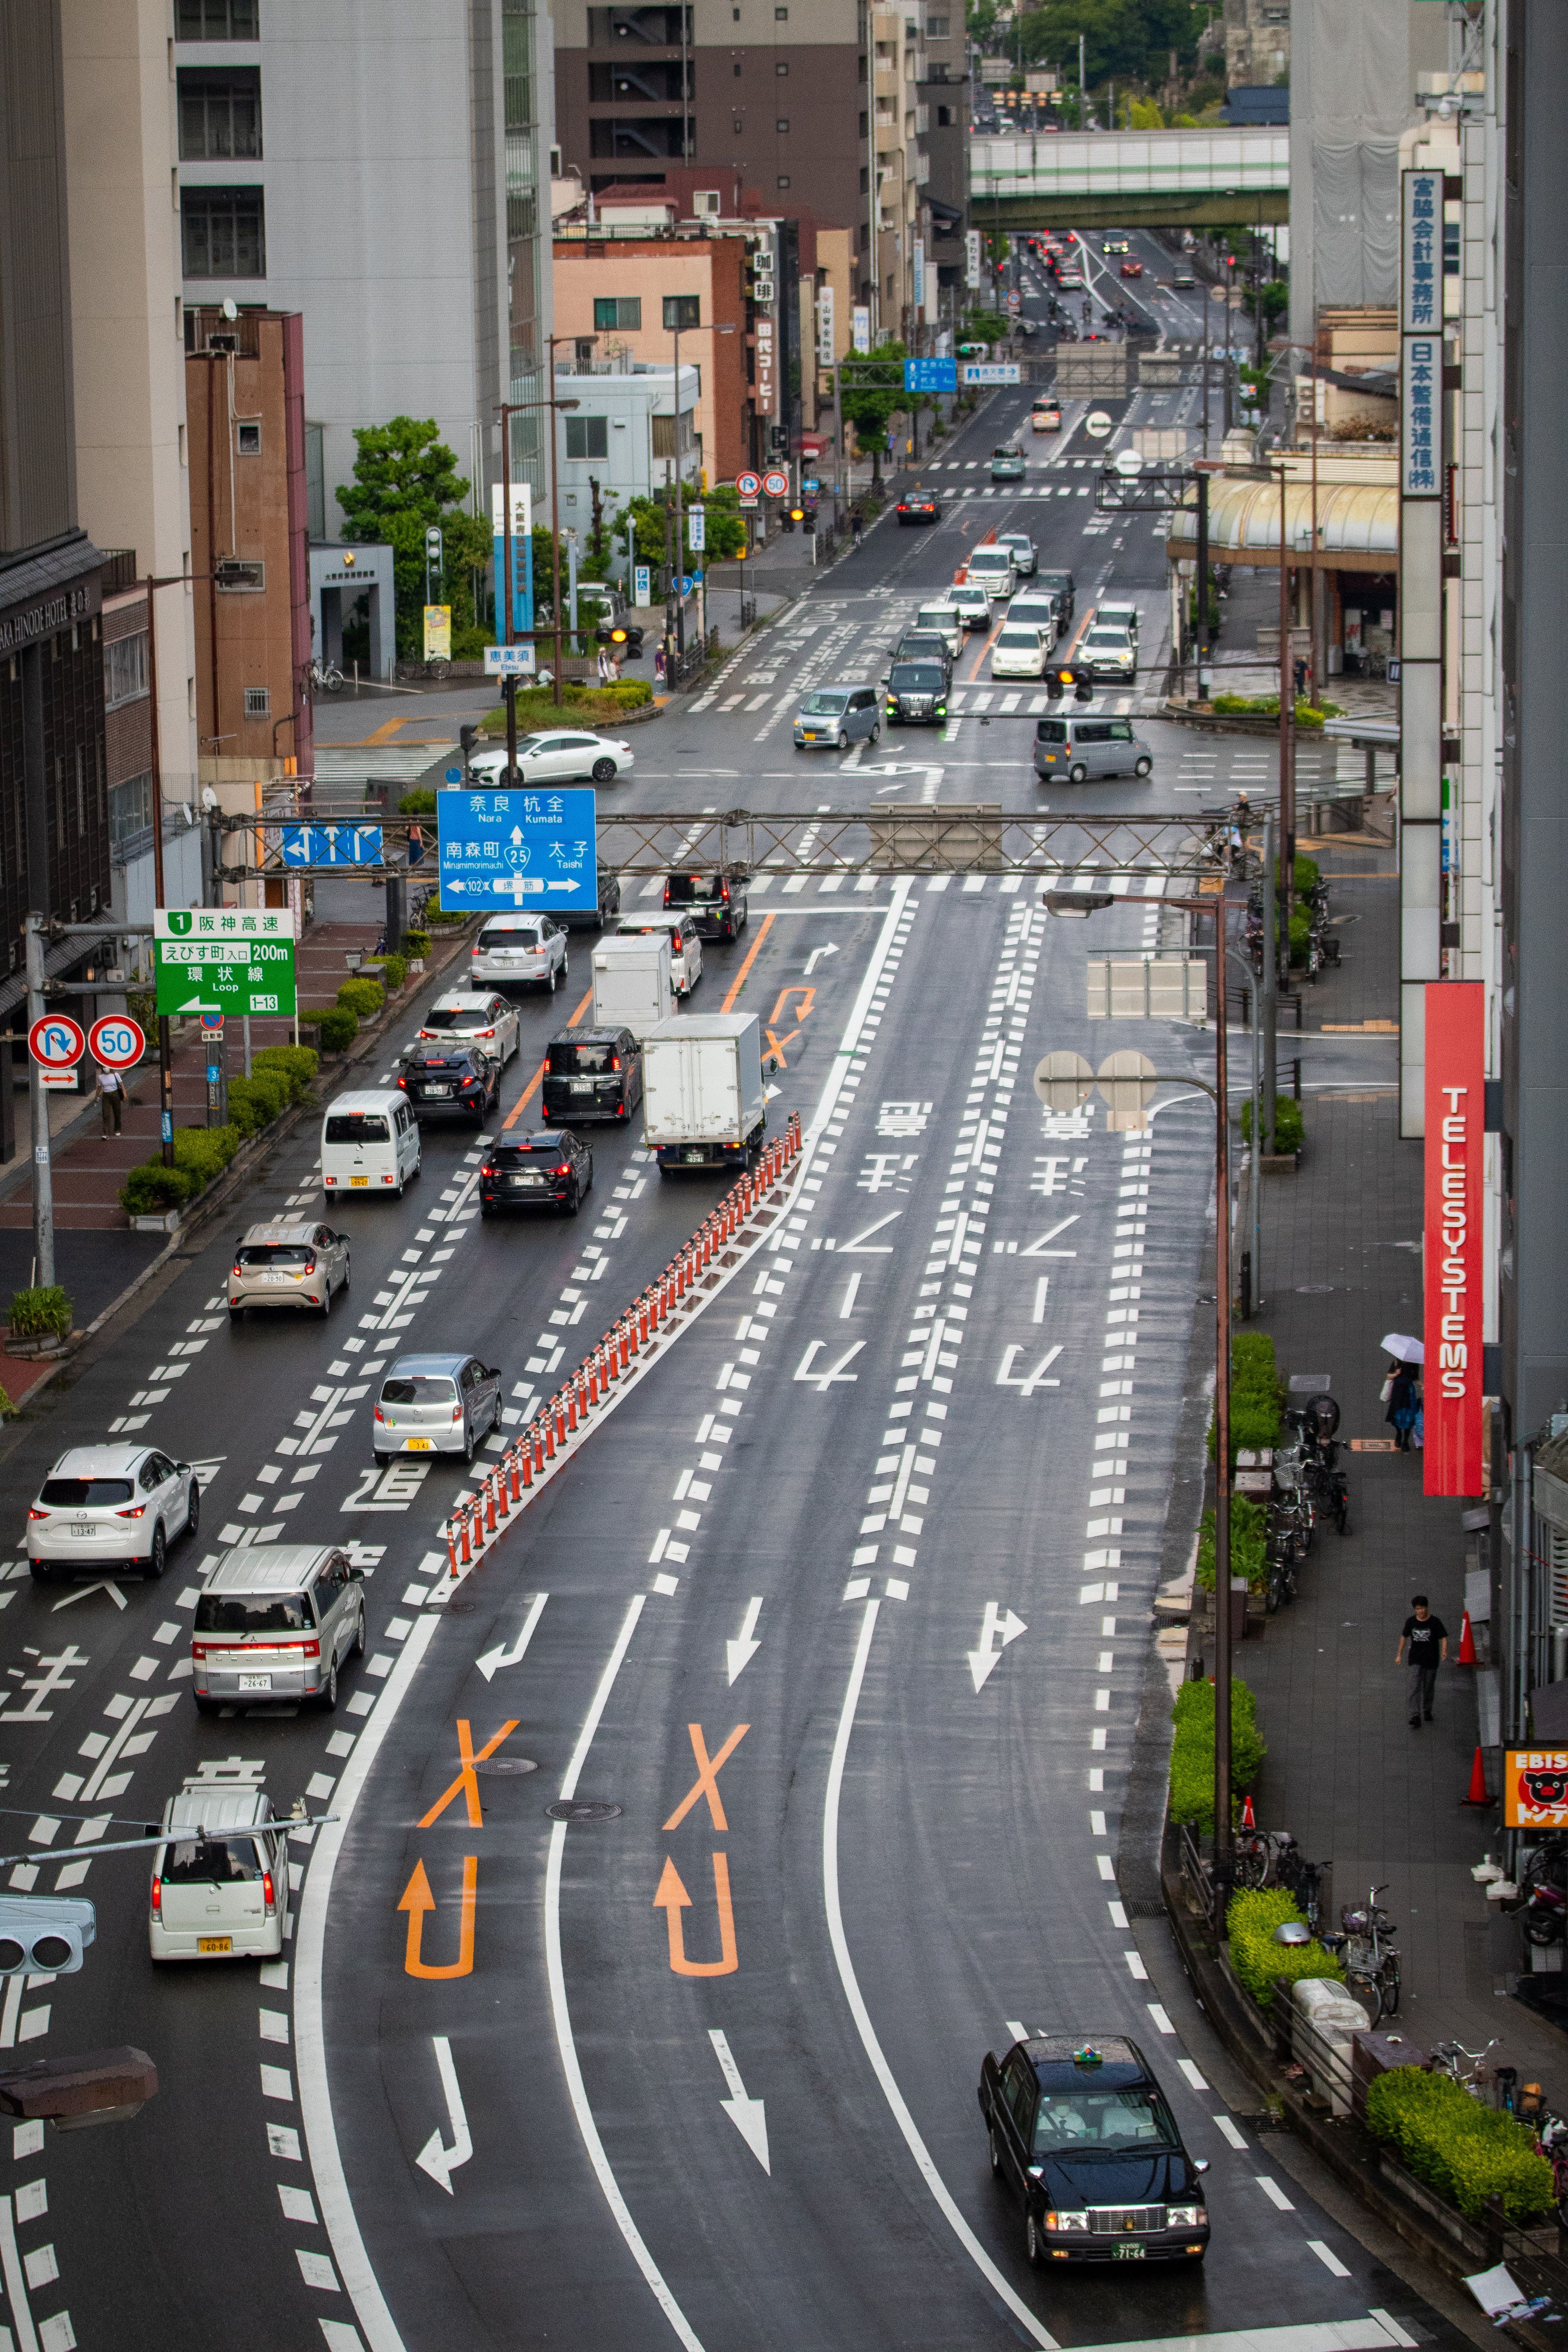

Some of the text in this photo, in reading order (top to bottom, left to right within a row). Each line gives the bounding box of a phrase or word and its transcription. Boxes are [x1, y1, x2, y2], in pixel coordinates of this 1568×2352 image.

[757, 323, 772, 411] 田代コーヒー
[768, 478, 783, 490] 50
[14, 607, 44, 643] HINODE
[44, 597, 68, 629] HOTEL
[470, 795, 564, 812] 奈良 杭全
[478, 814, 563, 823] Nara Kumata
[446, 842, 500, 858] 南森町
[510, 850, 527, 863] 25
[549, 841, 588, 858] 太子
[443, 861, 504, 869] Minamimorimachi
[556, 860, 583, 869] Taishi
[468, 881, 481, 892] 102
[503, 881, 534, 892] 堺筋
[176, 914, 184, 930] 1
[199, 916, 278, 931] 阪神高速
[253, 945, 288, 961] 200m
[187, 966, 263, 982] 環状線
[212, 983, 239, 993] Loop
[252, 996, 276, 1009] 1-13
[101, 1030, 132, 1054] 50
[1439, 1087, 1468, 1398] TELESYSTEMS
[1516, 1754, 1568, 1769] EBIS
[206, 1943, 229, 1951] 60-86
[1119, 2249, 1145, 2259] 71-64
